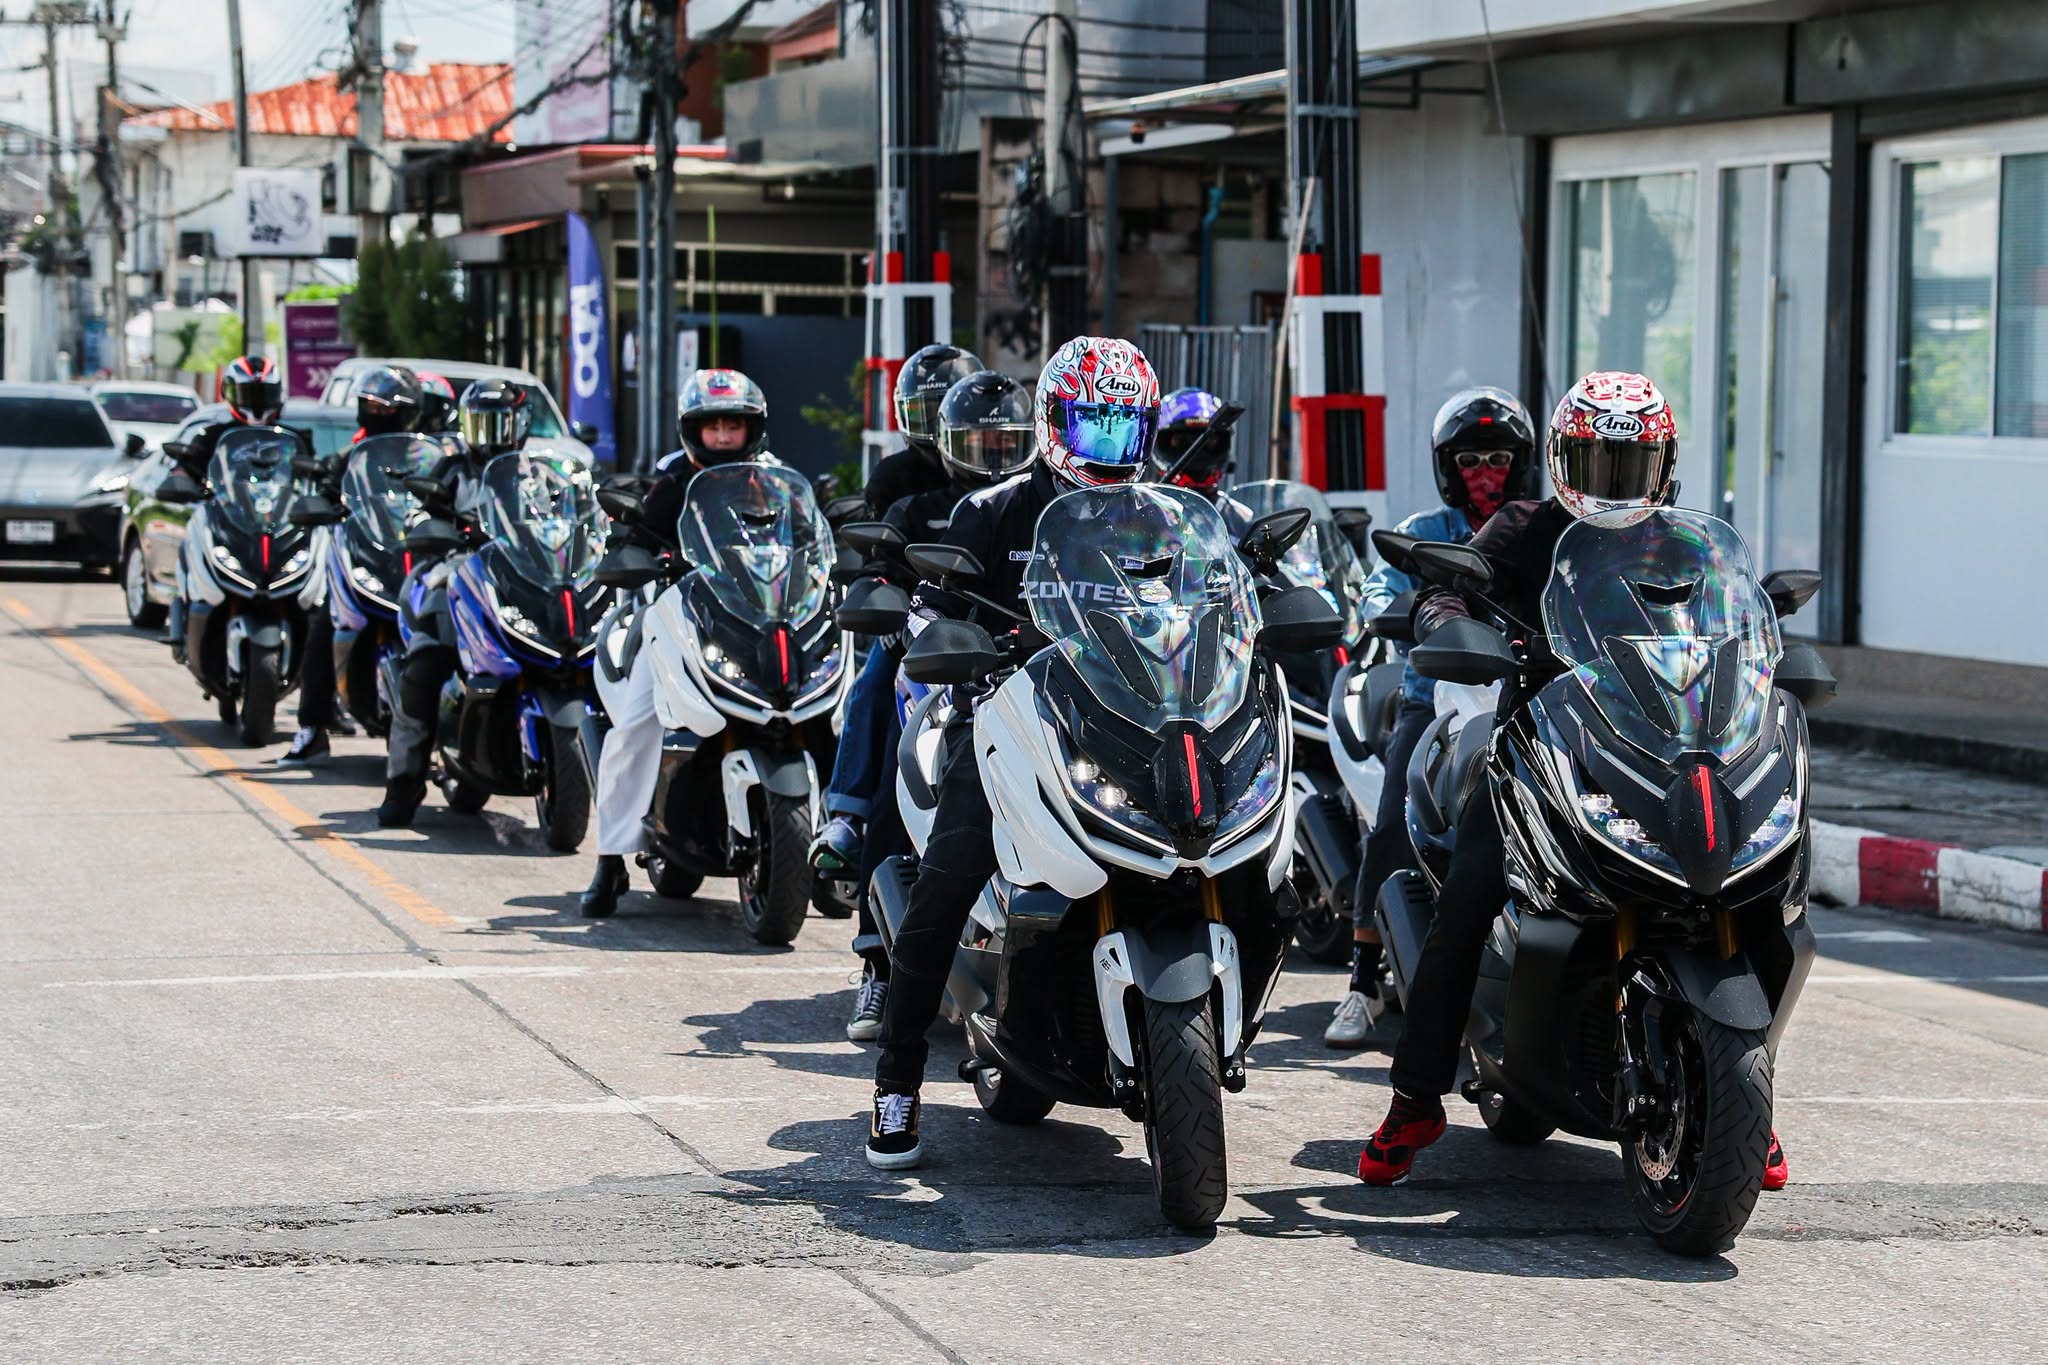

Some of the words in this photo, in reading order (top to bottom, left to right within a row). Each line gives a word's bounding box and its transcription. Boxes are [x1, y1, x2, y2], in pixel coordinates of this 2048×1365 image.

[917, 382, 948, 391] SHARK
[1099, 377, 1136, 391] Arai
[1595, 416, 1637, 431] Arai
[1018, 581, 1131, 604] ZONTES
